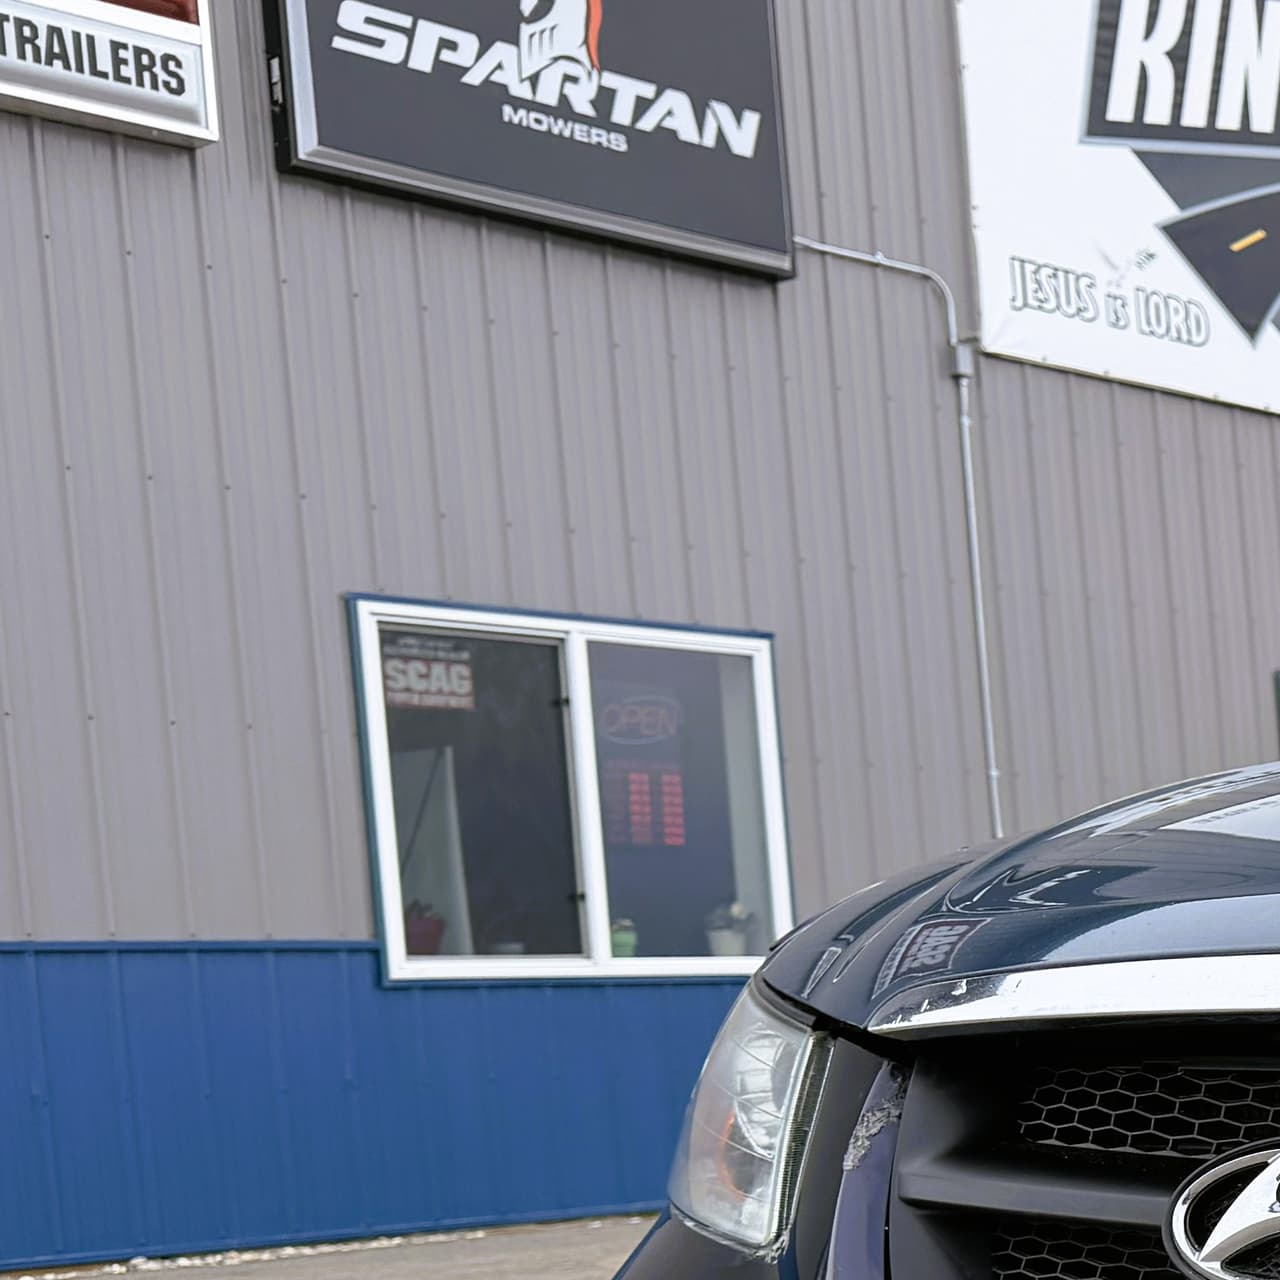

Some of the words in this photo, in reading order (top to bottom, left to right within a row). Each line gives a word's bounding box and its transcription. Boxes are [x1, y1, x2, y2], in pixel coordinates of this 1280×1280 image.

[331, 0, 761, 158] SPARTAN
[501, 103, 628, 152] MOWERS
[1008, 255, 1099, 323] JESUS
[1134, 285, 1210, 348] LORD
[384, 658, 473, 696] SCAG
